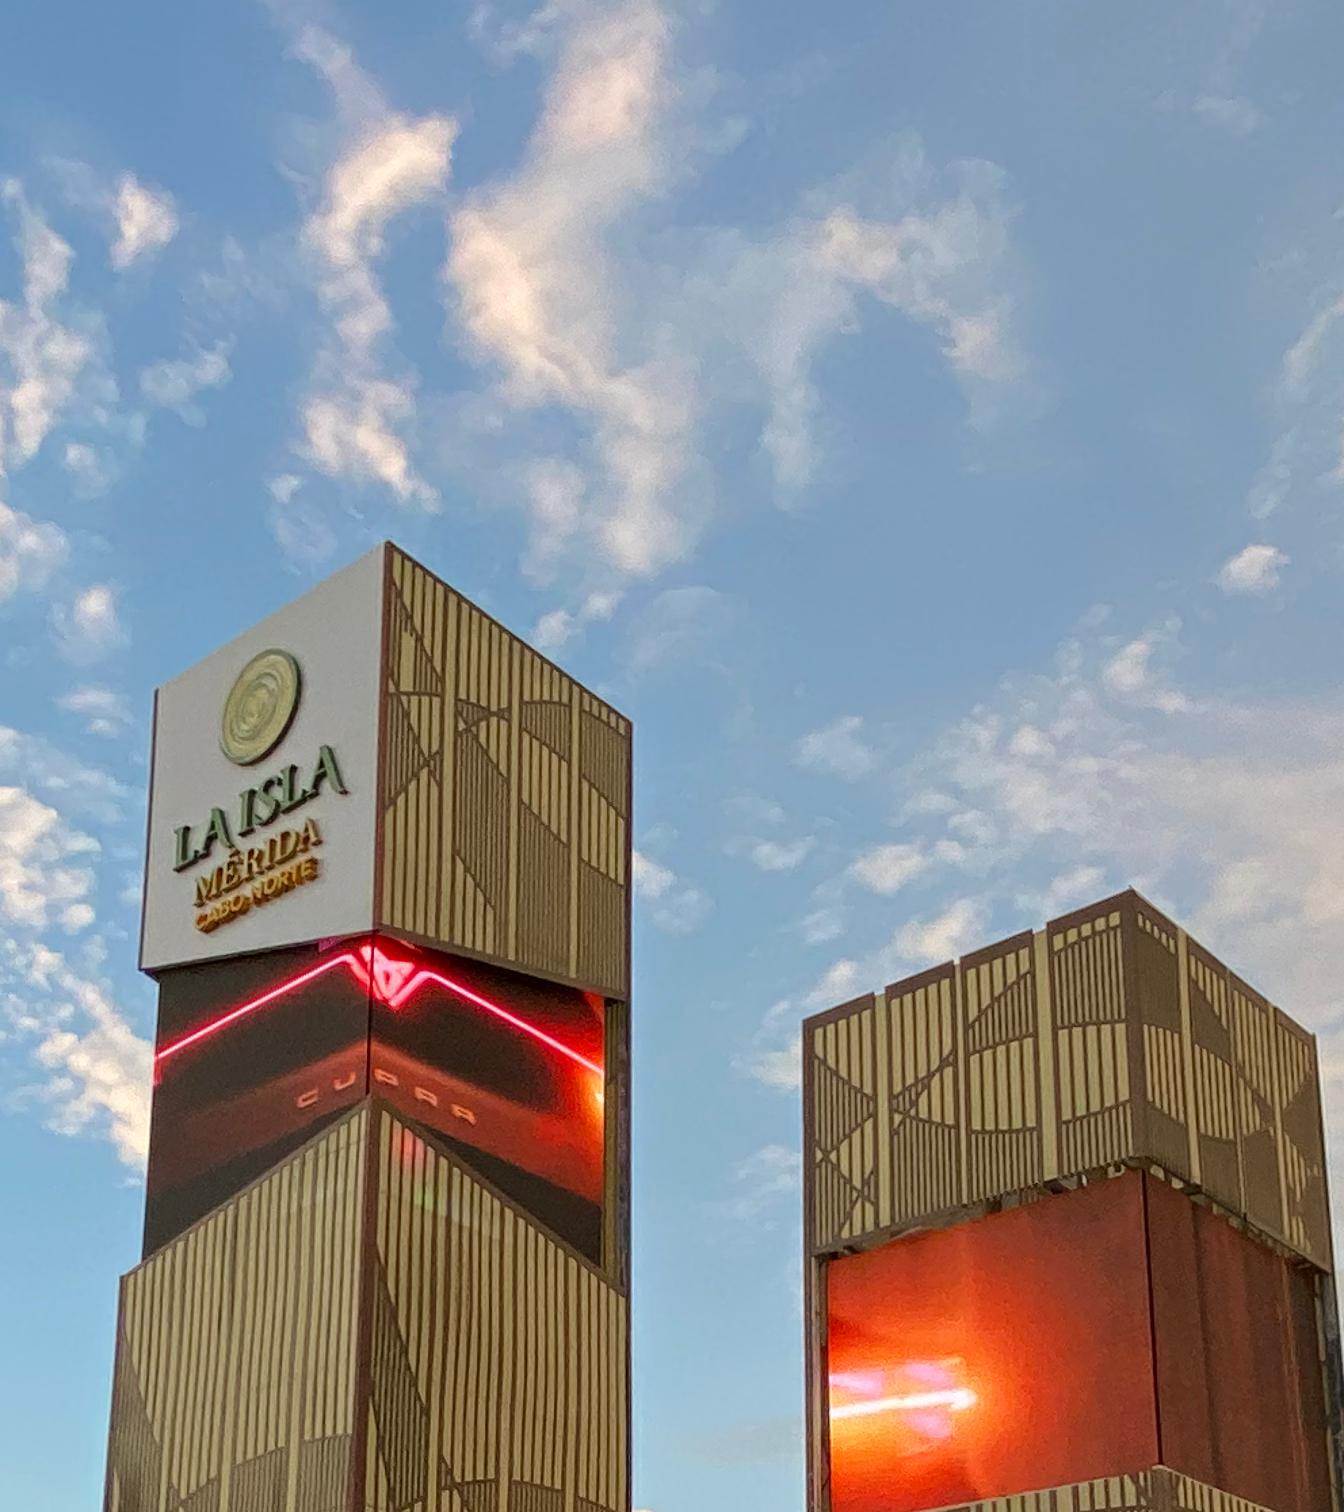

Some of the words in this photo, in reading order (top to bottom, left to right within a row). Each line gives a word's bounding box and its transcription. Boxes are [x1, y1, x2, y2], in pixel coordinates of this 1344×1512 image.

[172, 807, 236, 873] LA
[238, 744, 350, 838] ISLA
[193, 817, 323, 908] MÉRIDA
[195, 895, 251, 934] CABO
[251, 857, 319, 907] NORTE
